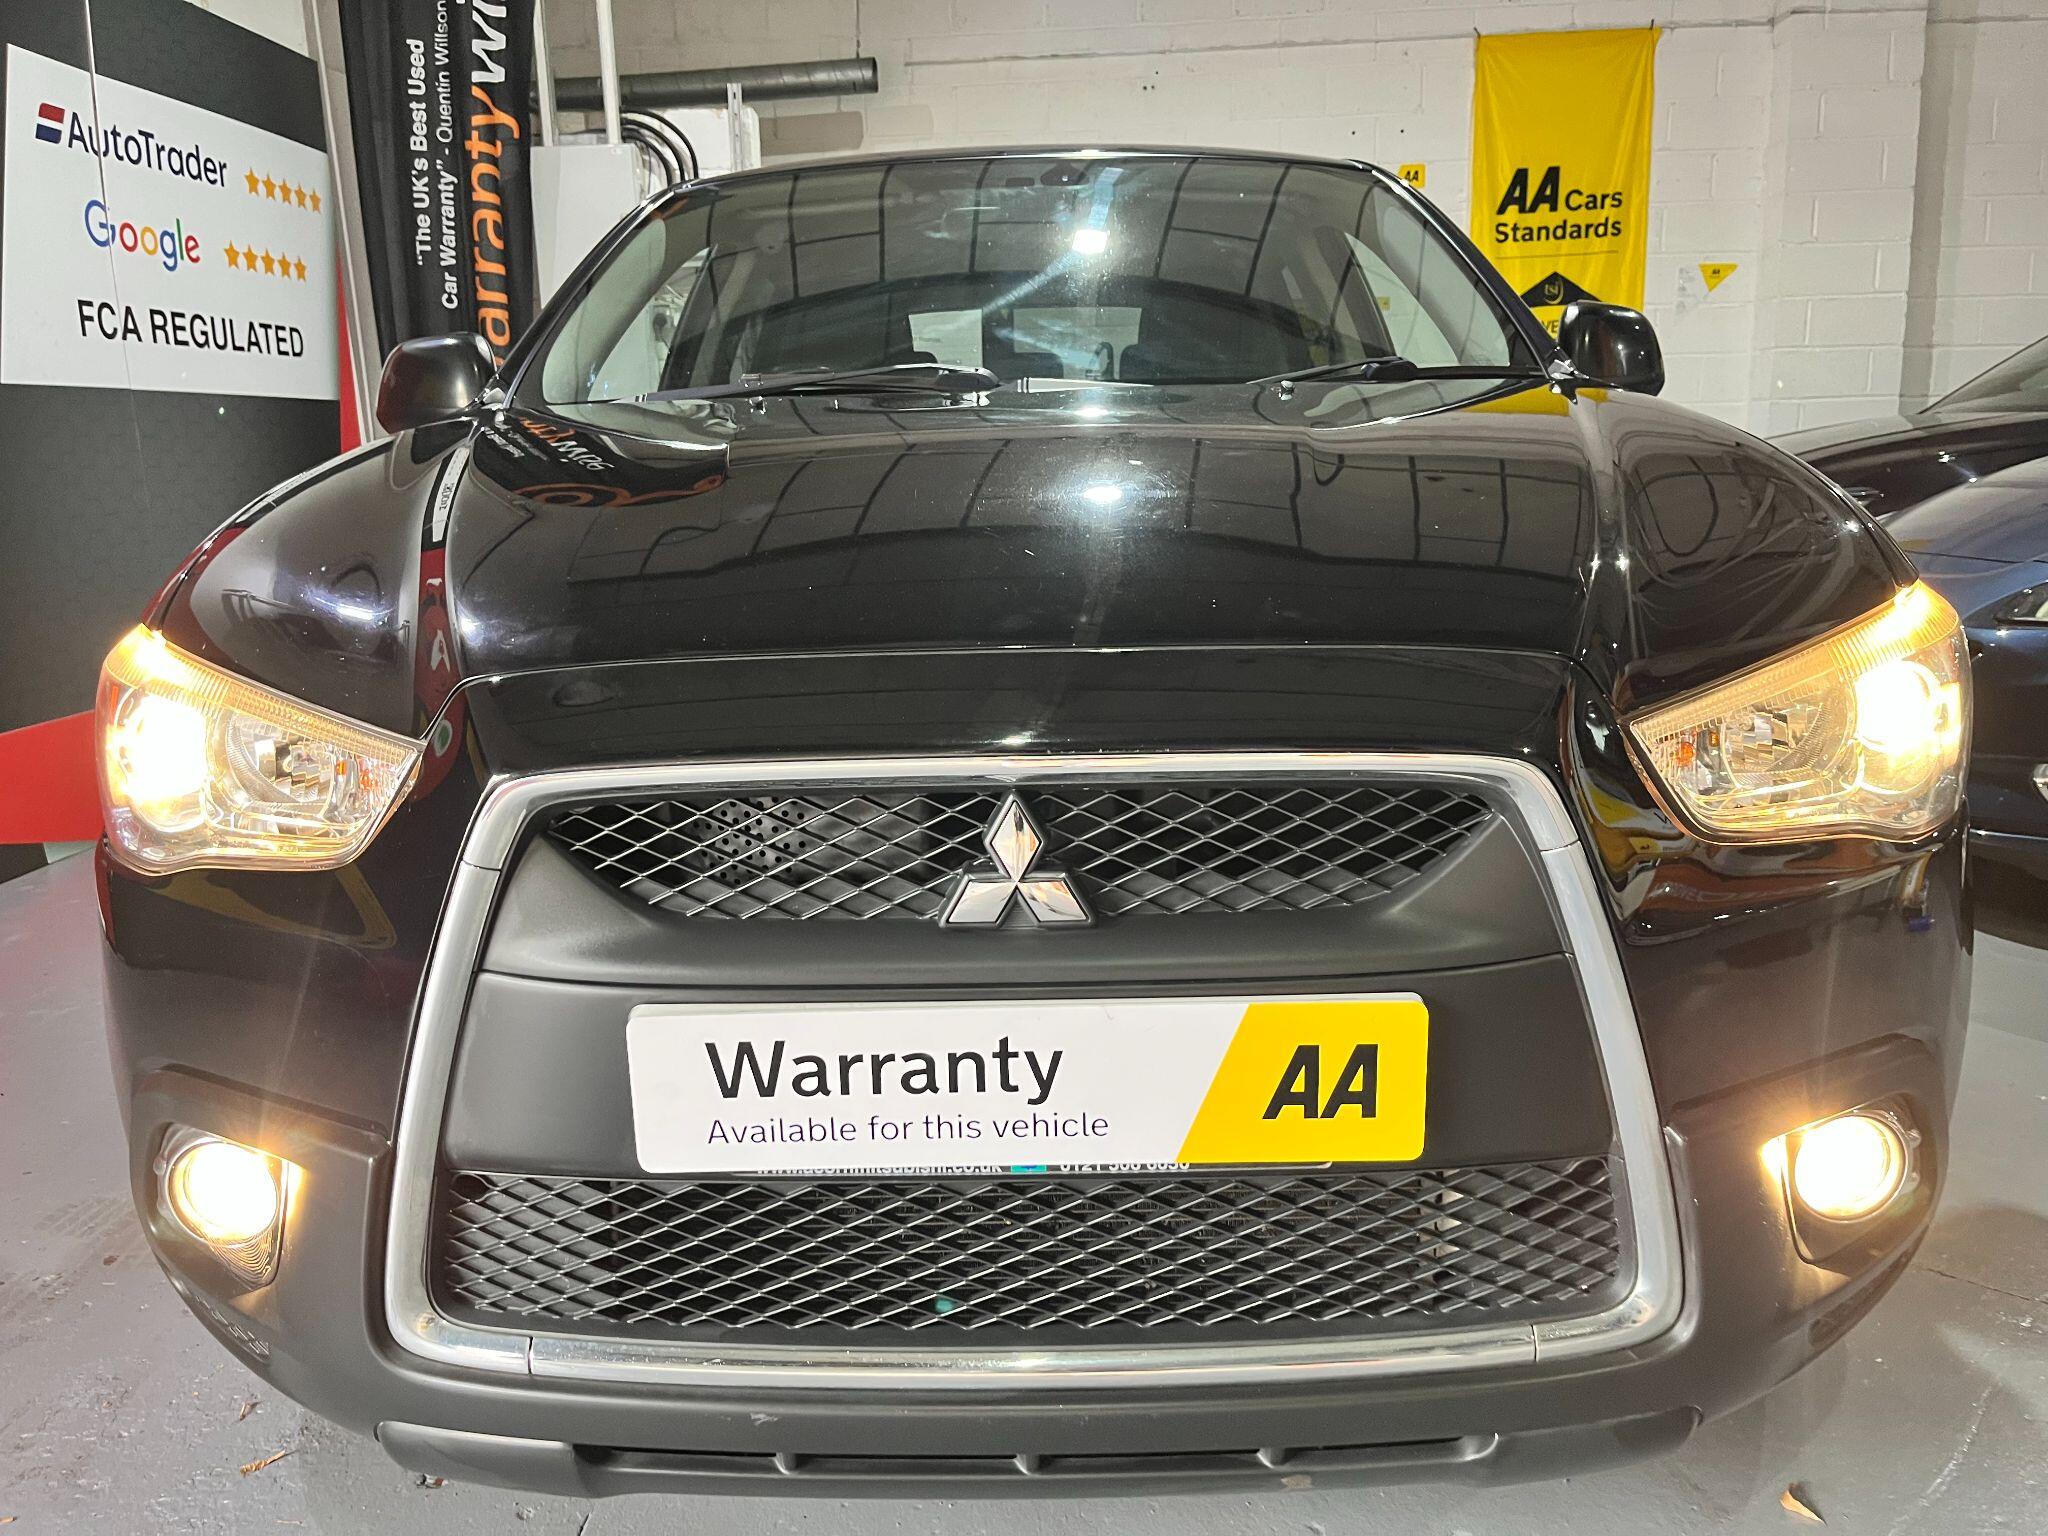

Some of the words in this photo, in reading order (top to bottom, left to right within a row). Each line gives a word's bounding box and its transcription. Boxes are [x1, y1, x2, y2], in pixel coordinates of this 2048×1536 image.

[434, 0, 449, 65] Willson
[406, 38, 426, 95] Used
[409, 101, 427, 151] Best
[436, 71, 453, 143] Quentin
[68, 111, 227, 187] AutoTrader
[1403, 170, 1418, 181] AA
[411, 157, 429, 208] UK’s
[456, 0, 520, 366] arrantywi
[1496, 166, 1560, 215] AA
[1565, 189, 1622, 212] Cars
[84, 199, 201, 271] Google
[1495, 217, 1622, 243] Standards
[441, 271, 458, 309] Car
[77, 299, 143, 342] FCA
[149, 308, 305, 357] REGULATED
[705, 1036, 1063, 1105] Warranty
[1262, 1043, 1379, 1120] AA
[708, 1118, 857, 1145] Available
[868, 1116, 914, 1140] for
[923, 1114, 982, 1140] this
[993, 1111, 1110, 1139] vehicle
